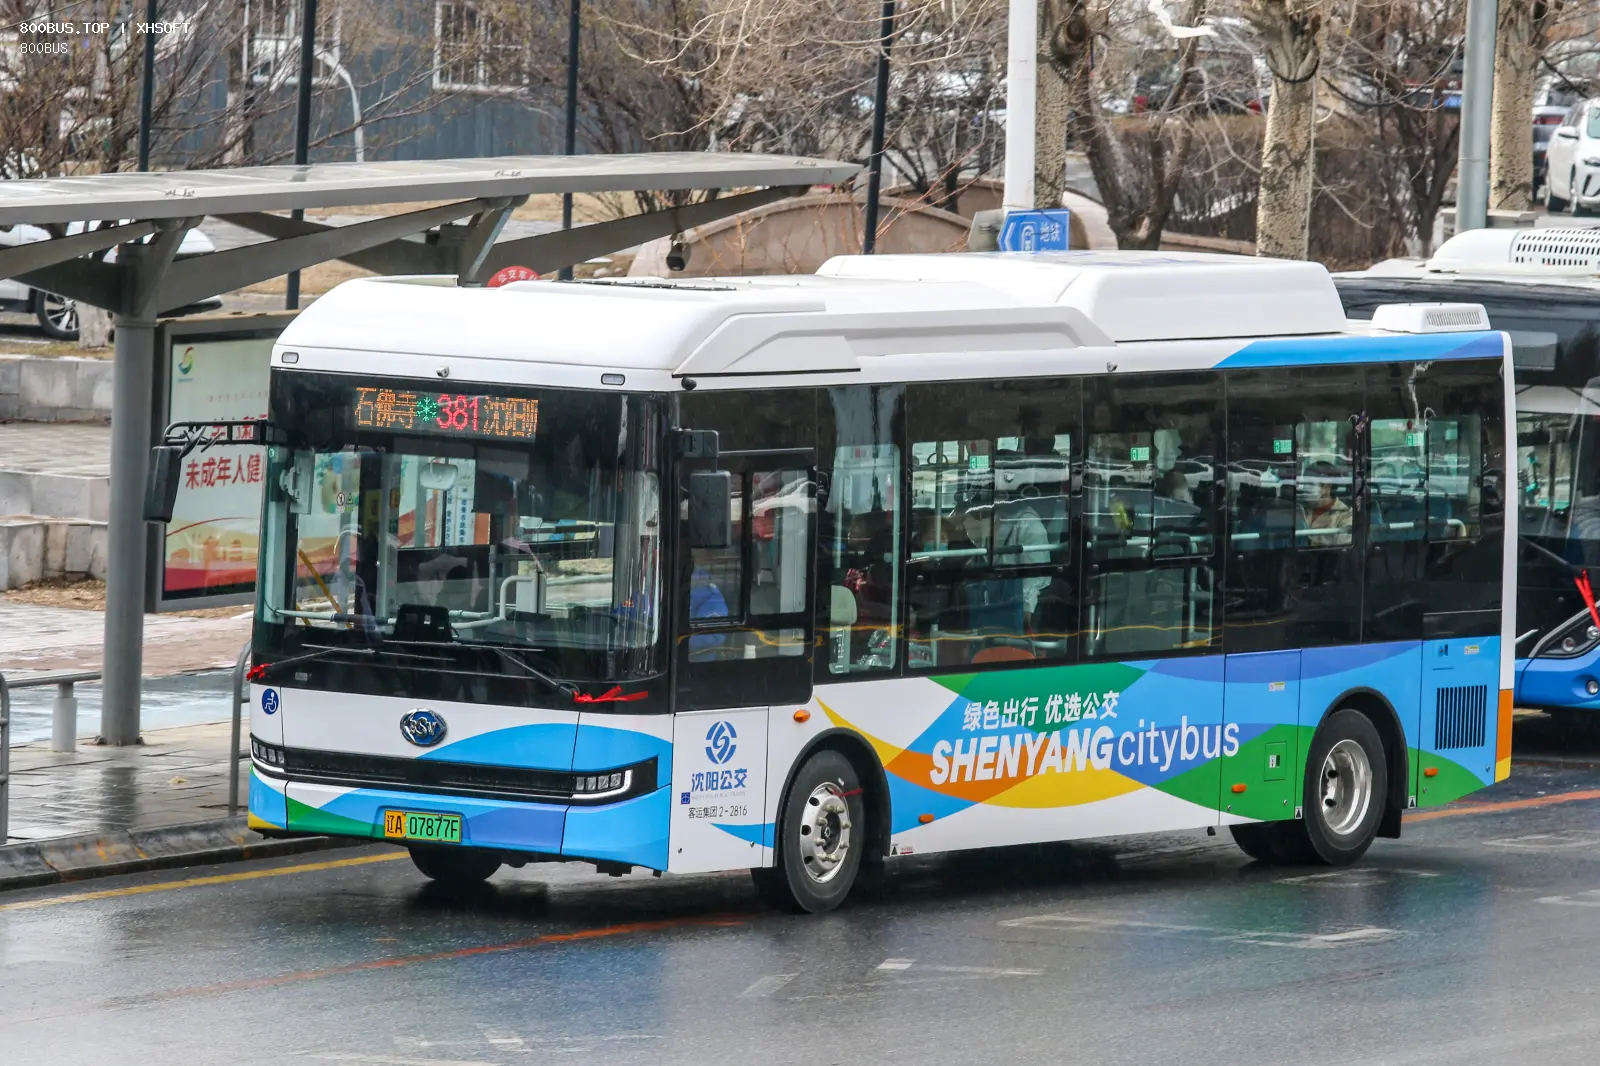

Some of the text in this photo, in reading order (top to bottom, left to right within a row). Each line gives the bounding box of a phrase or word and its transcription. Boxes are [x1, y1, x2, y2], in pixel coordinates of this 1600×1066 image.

[436, 393, 479, 431] 381
[185, 453, 265, 489] 未成年人健
[962, 690, 1120, 732] 绿色出行 优选公交
[929, 715, 1240, 786] SHENYANG citybus
[691, 768, 748, 792] 沈阳公交
[409, 816, 459, 838] 07877F
[688, 805, 717, 819] 客运集团
